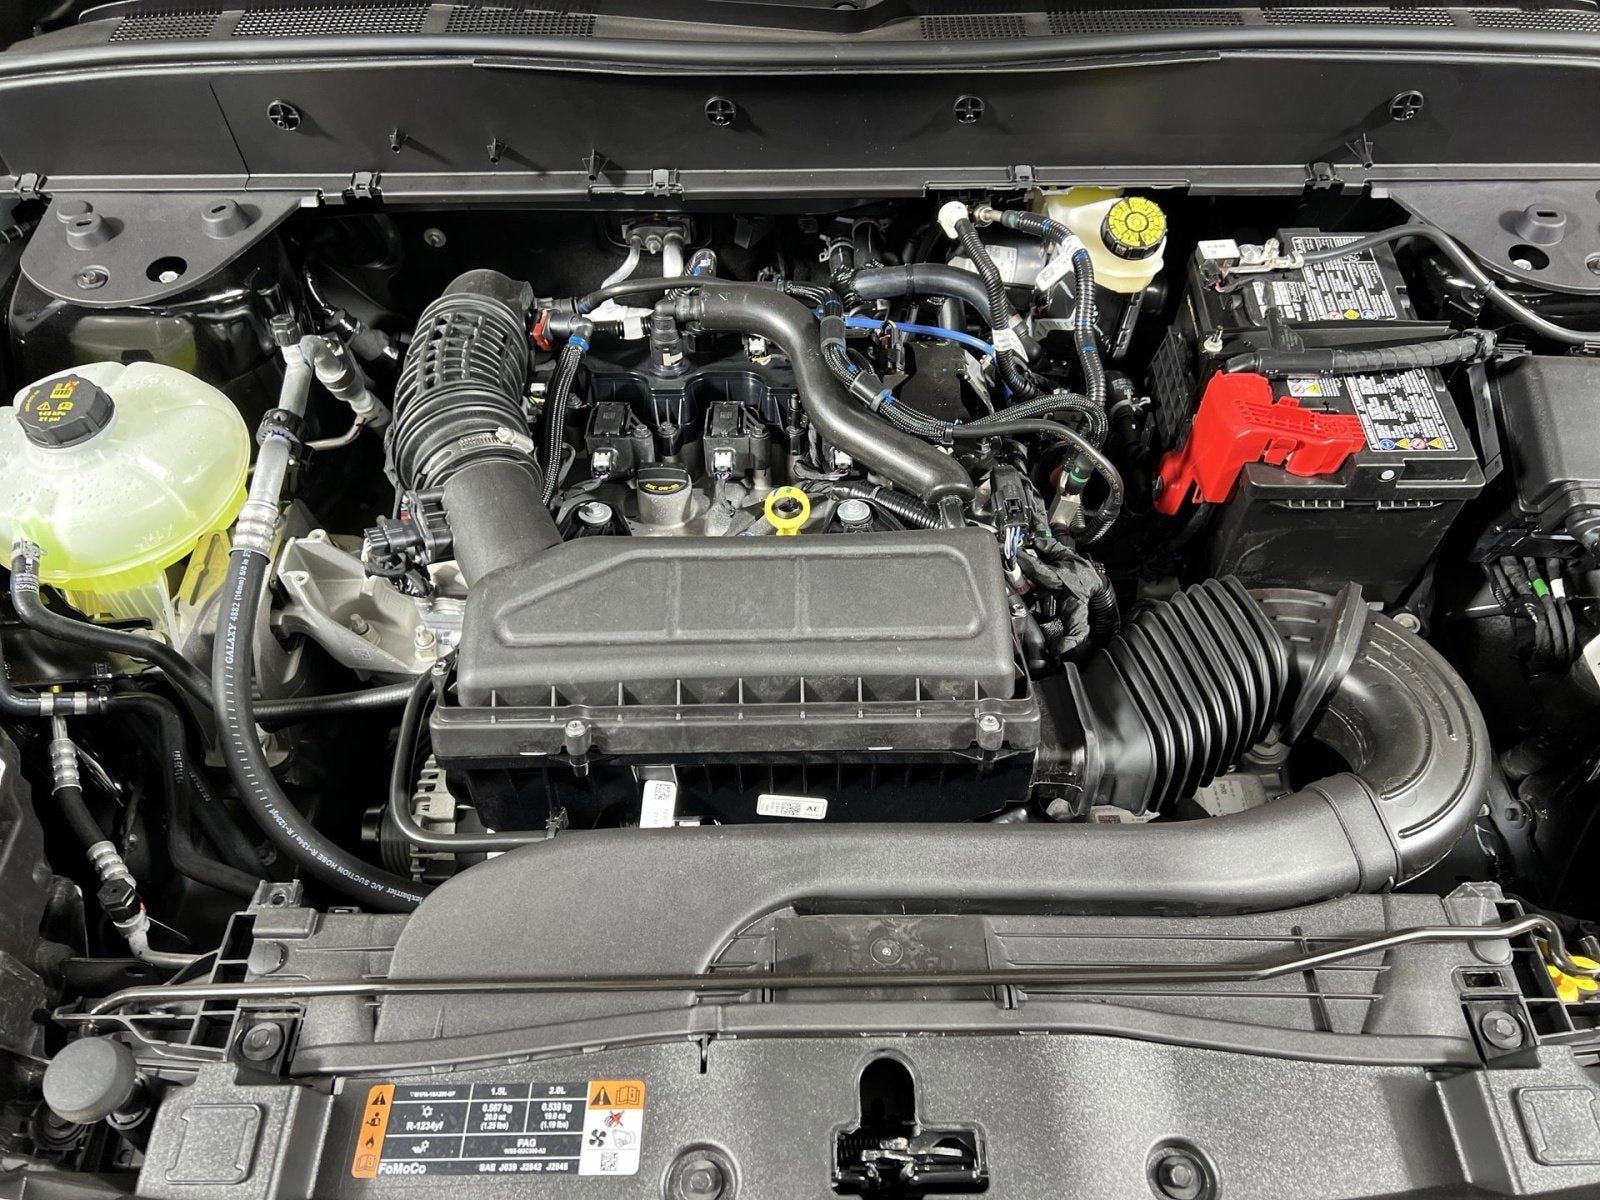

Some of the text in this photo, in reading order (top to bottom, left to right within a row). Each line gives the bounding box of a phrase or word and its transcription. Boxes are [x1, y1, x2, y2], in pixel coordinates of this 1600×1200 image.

[225, 623, 237, 664] GALAXY
[296, 836, 319, 856] R-134a
[316, 853, 338, 870] HOSE
[337, 866, 370, 886] SUCTION
[370, 881, 384, 891] A/C
[490, 1087, 508, 1096] 1.5L
[548, 1086, 566, 1095] 2.0L
[502, 1103, 513, 1114] kg
[561, 1102, 573, 1113] kg
[406, 1121, 444, 1132] R-1234yf
[516, 1138, 537, 1147] PAG
[378, 1162, 426, 1176] FoMoCo
[479, 1163, 496, 1172] SAE
